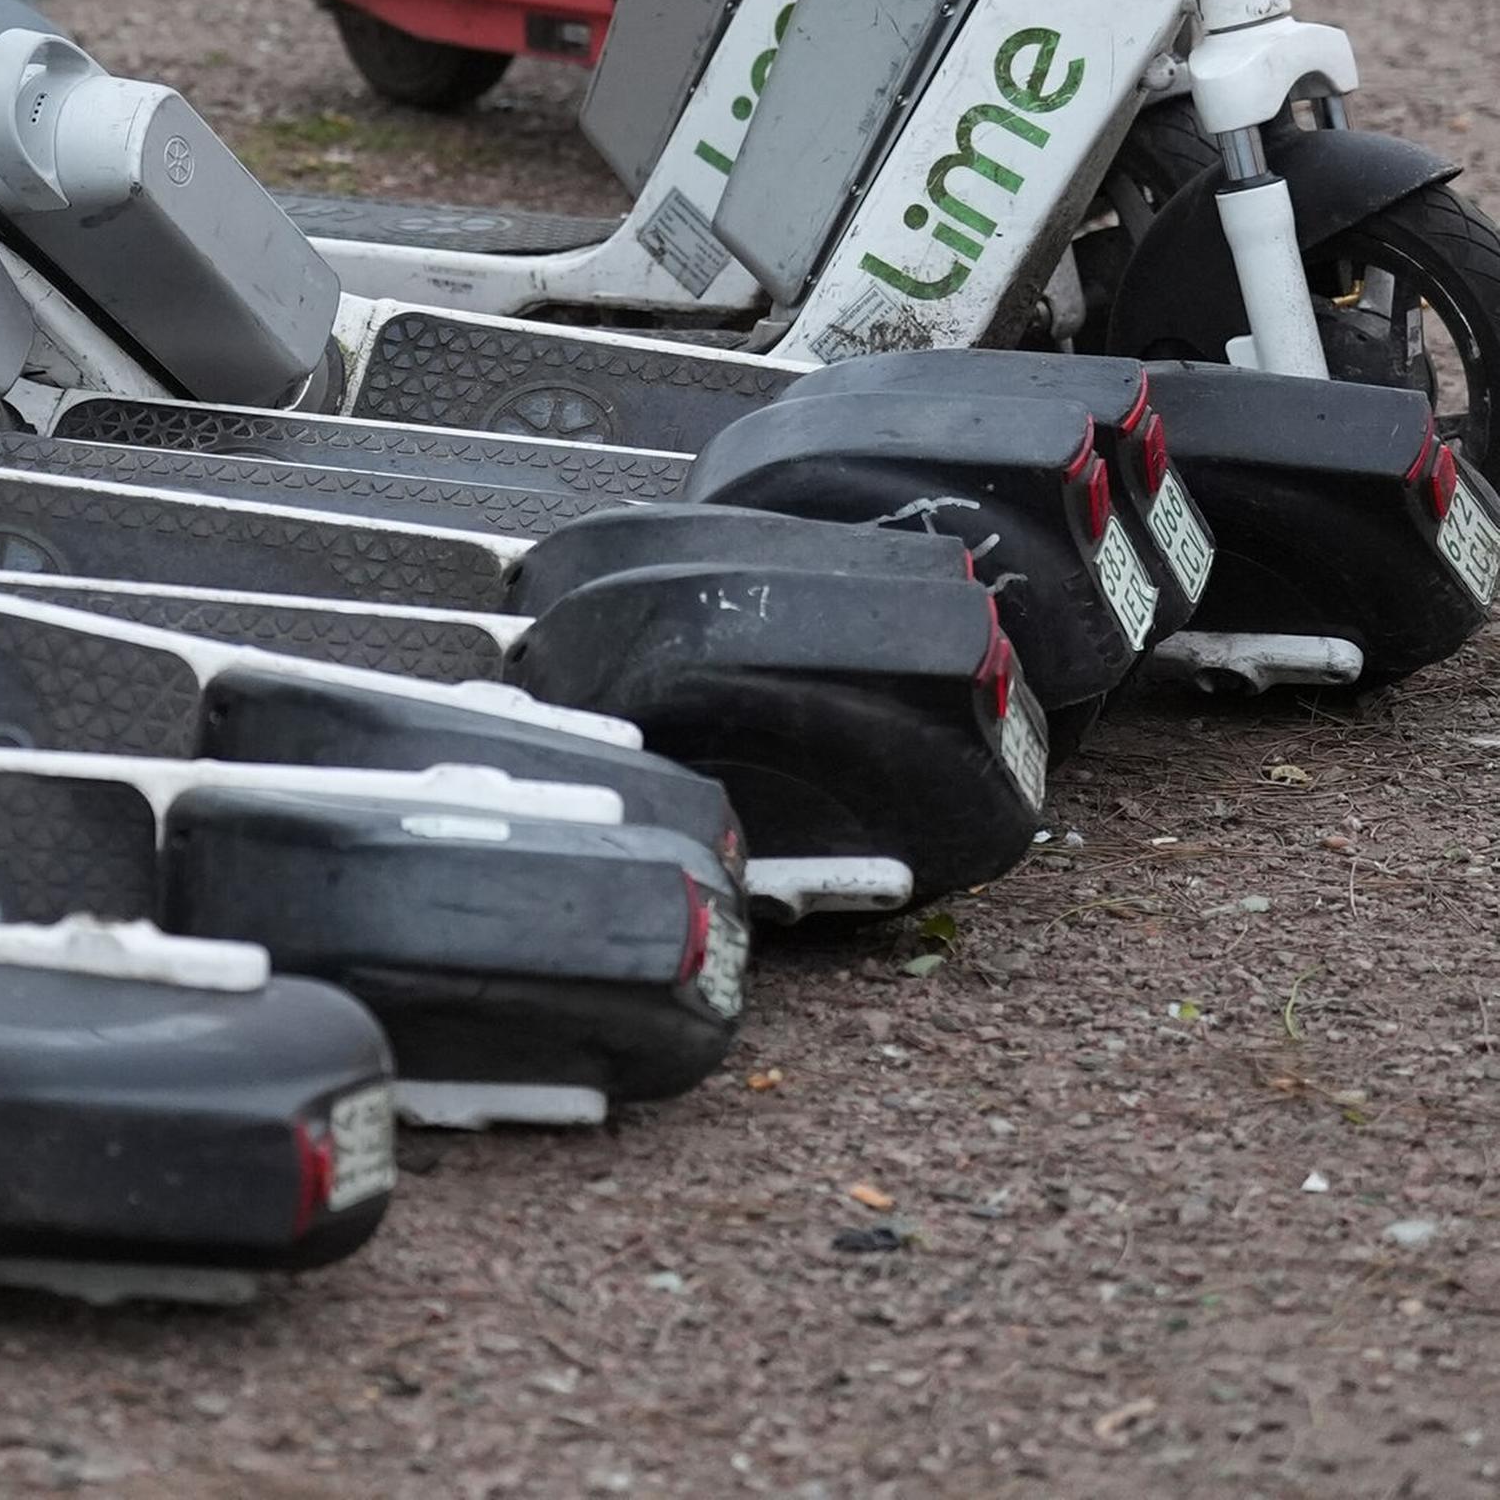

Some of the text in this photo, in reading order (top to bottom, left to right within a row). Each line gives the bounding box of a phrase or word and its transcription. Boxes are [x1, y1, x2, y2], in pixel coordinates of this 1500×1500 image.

[857, 26, 1086, 301] Lime
[1175, 521, 1206, 590] ICV
[1442, 491, 1473, 562] 672
[1099, 529, 1127, 598] 383
[1119, 572, 1154, 640] IER
